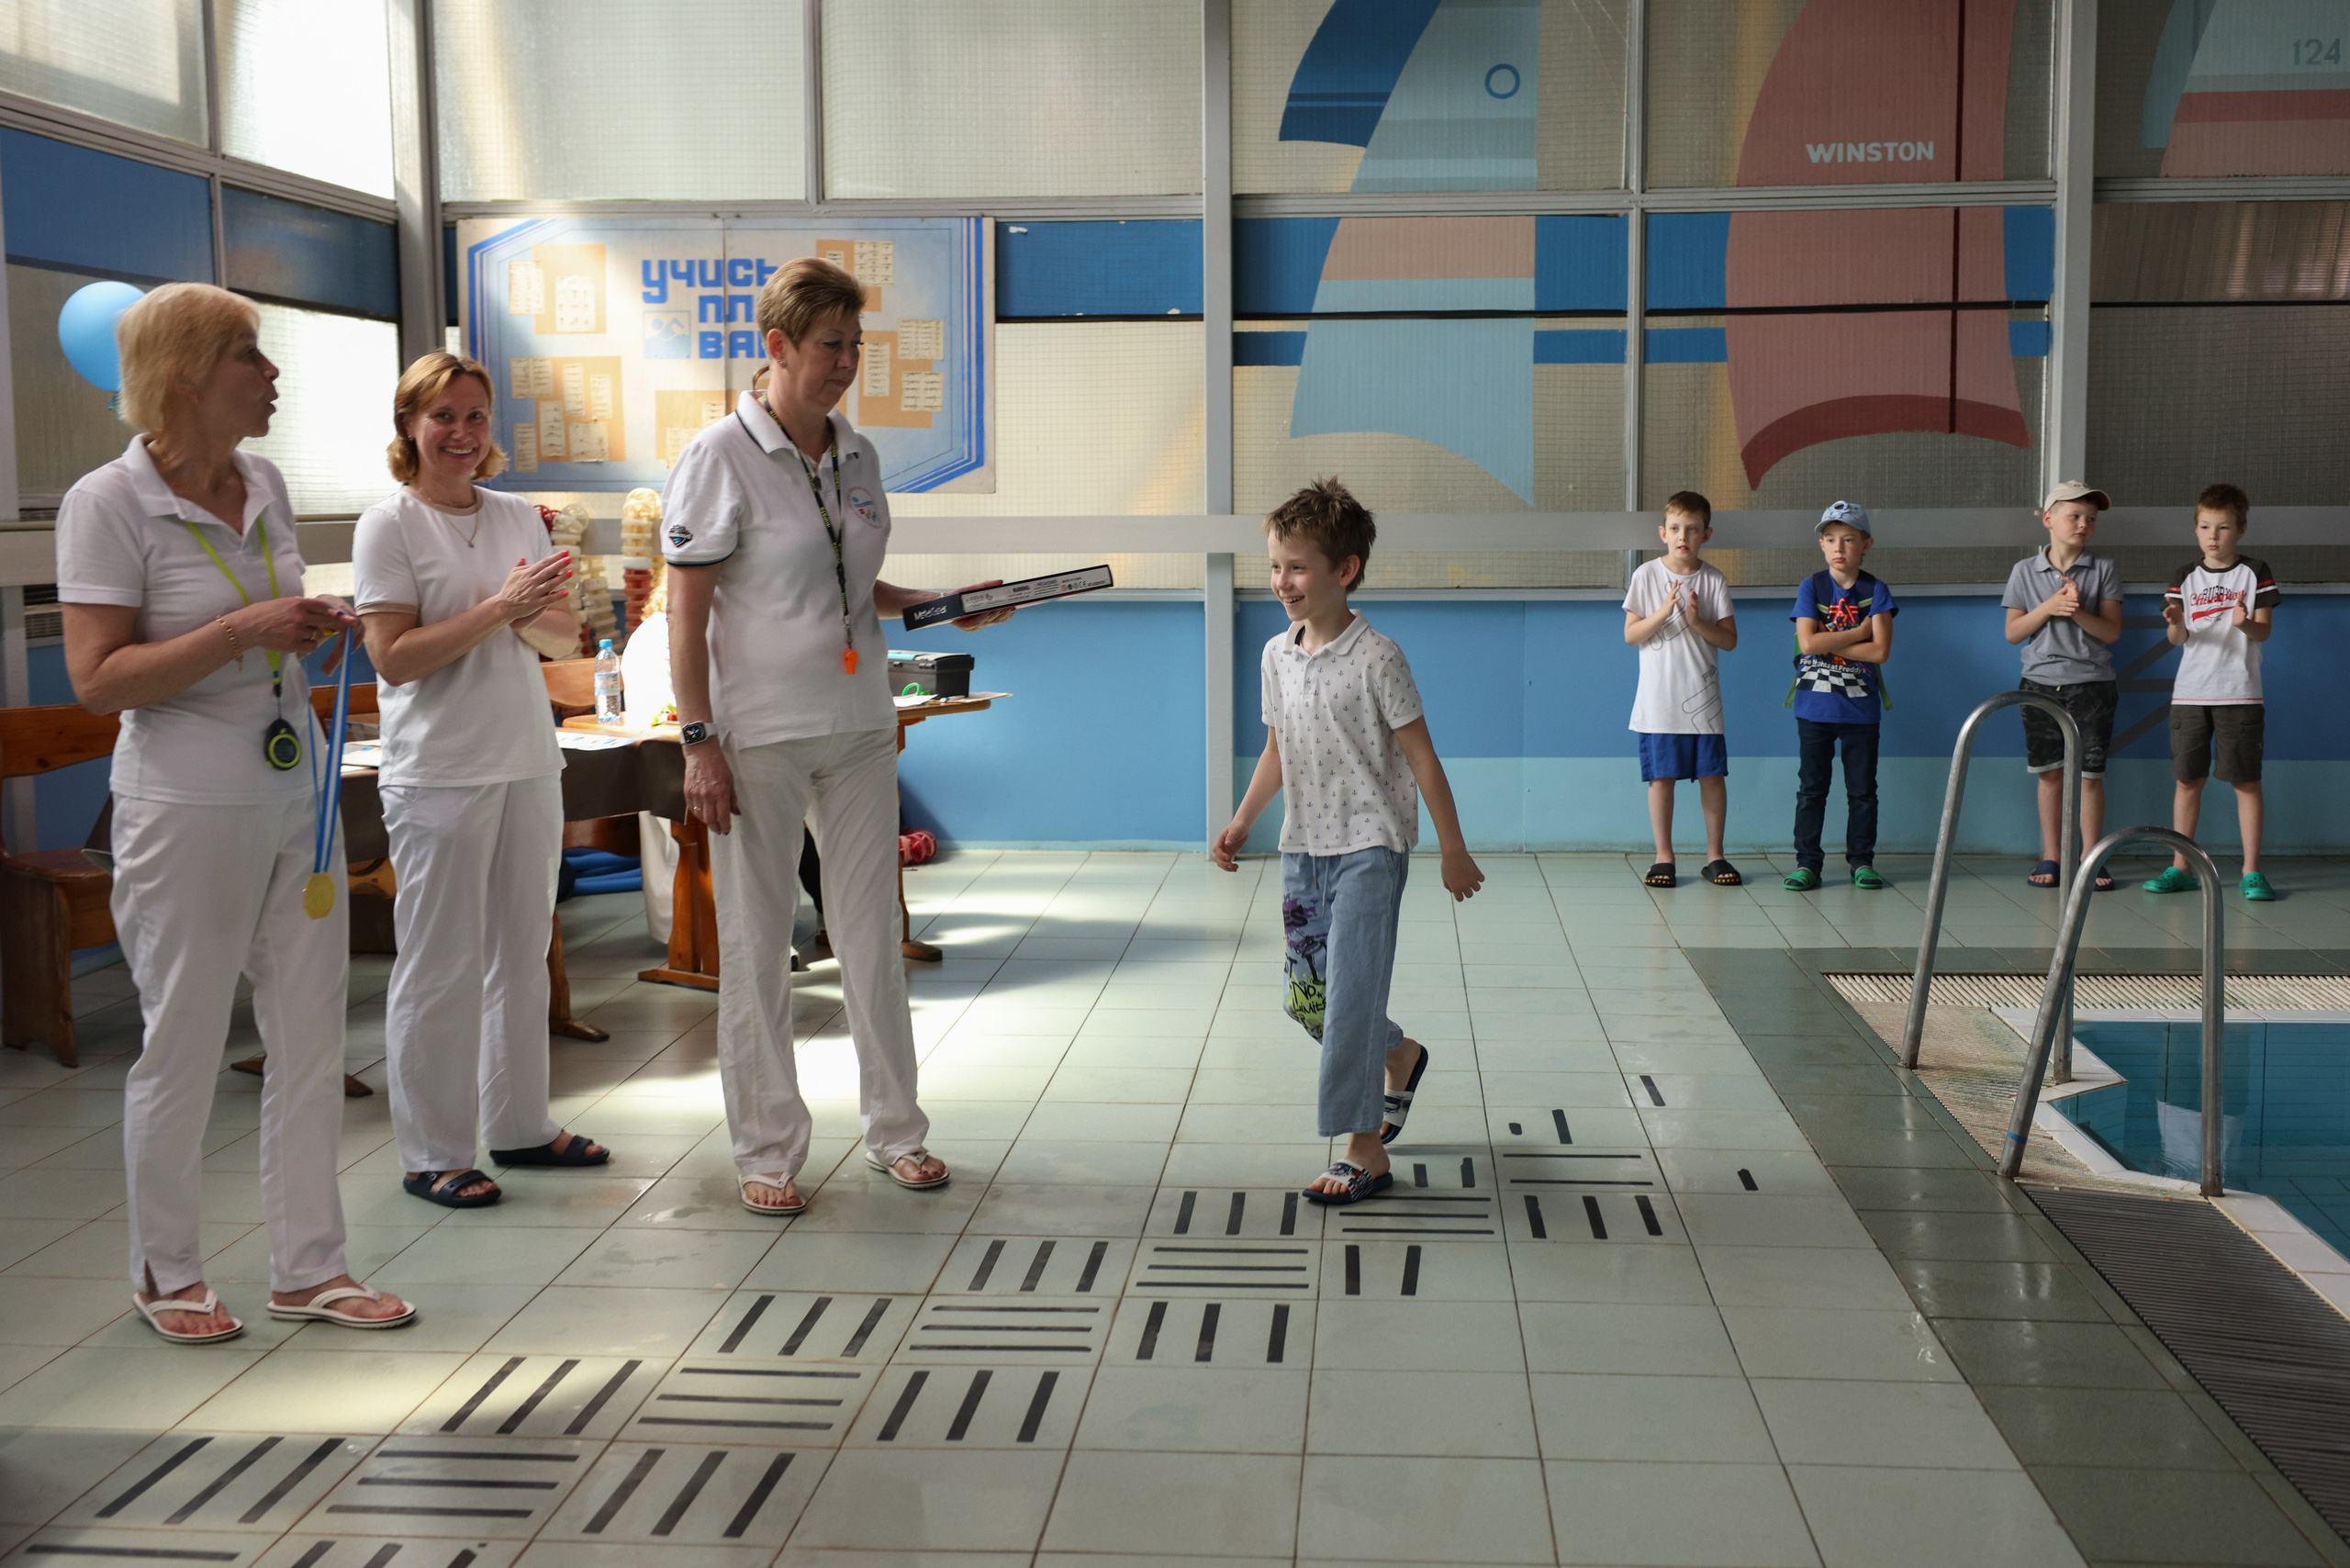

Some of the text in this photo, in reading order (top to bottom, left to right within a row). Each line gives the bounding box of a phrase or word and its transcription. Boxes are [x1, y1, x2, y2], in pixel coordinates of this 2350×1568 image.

[2293, 38, 2341, 65] 124
[1806, 140, 1934, 163] WINSTON
[699, 294, 755, 323] ПЛ
